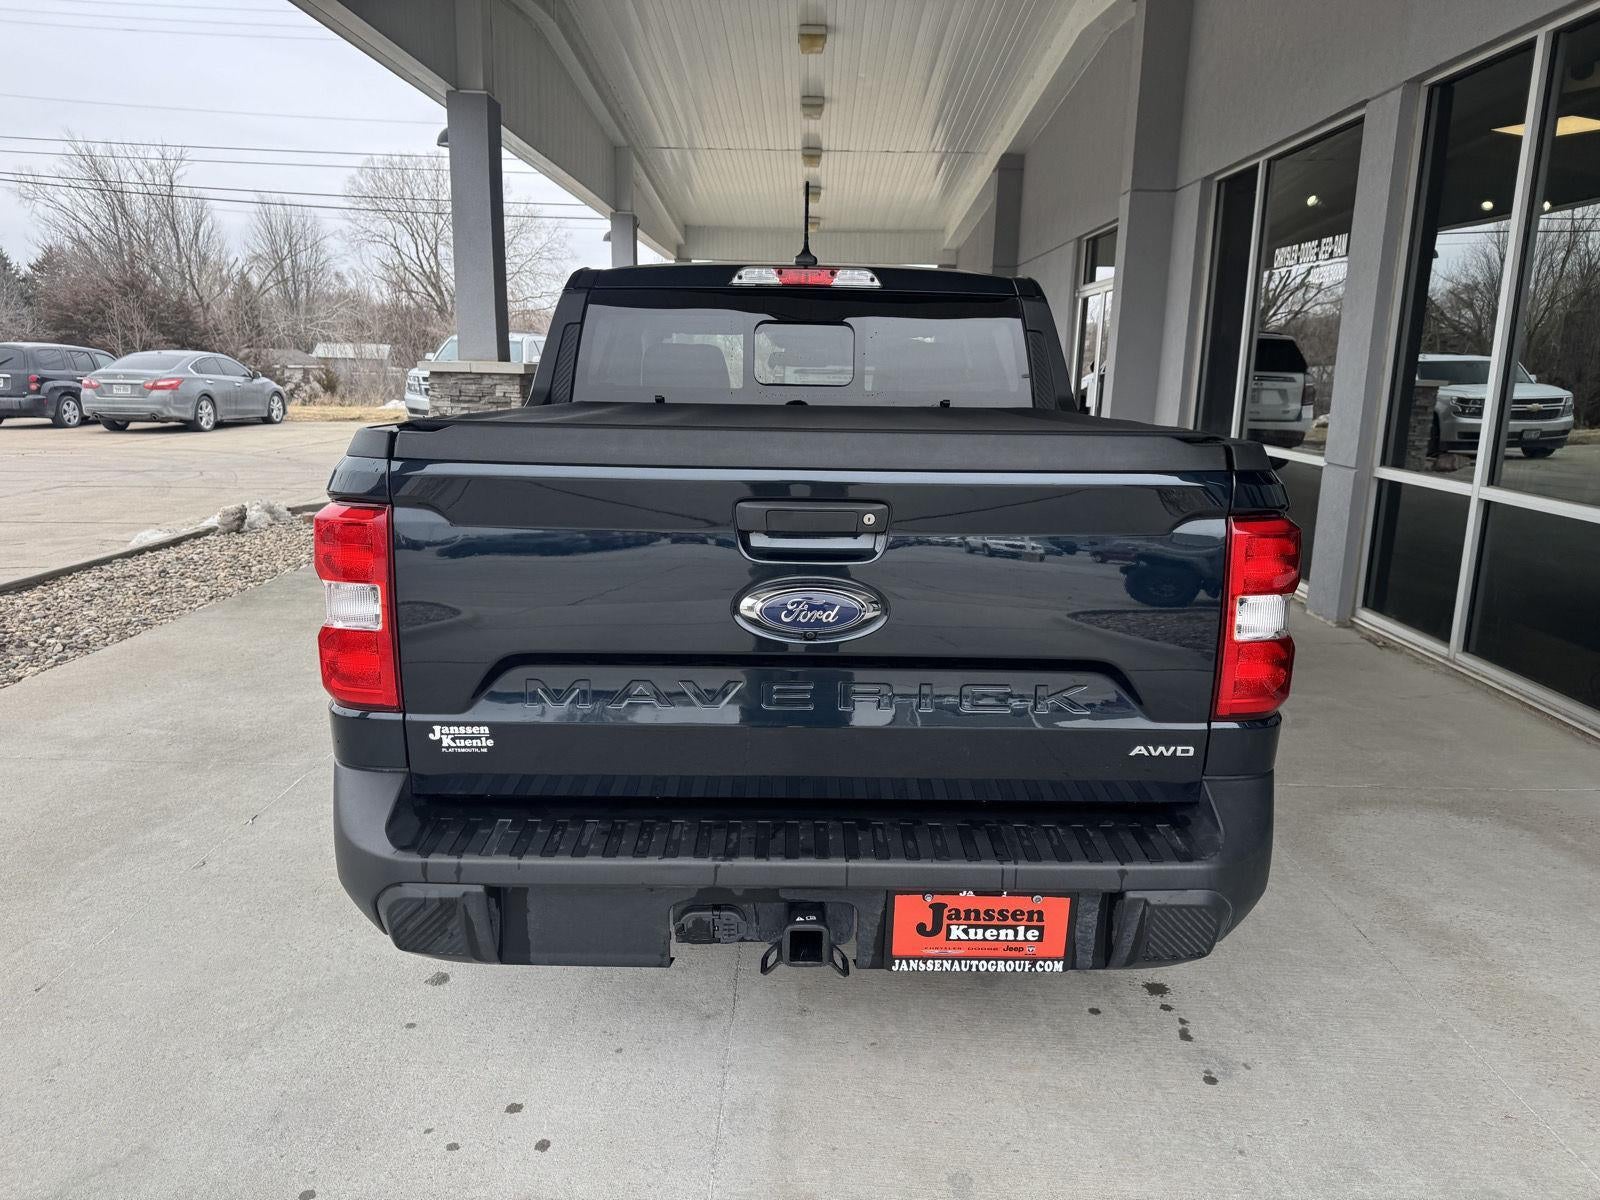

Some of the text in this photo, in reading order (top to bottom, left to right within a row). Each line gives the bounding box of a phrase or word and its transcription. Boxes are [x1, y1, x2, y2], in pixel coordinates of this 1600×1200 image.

[781, 598, 840, 623] Ford
[523, 677, 1091, 714] MAVERICK
[428, 725, 490, 740] Janssen
[441, 735, 494, 747] Kuenle
[1128, 745, 1195, 757] AWD
[916, 902, 1044, 937] Janssen
[948, 925, 1040, 941] Kuenle
[1003, 945, 1024, 953] Jeep
